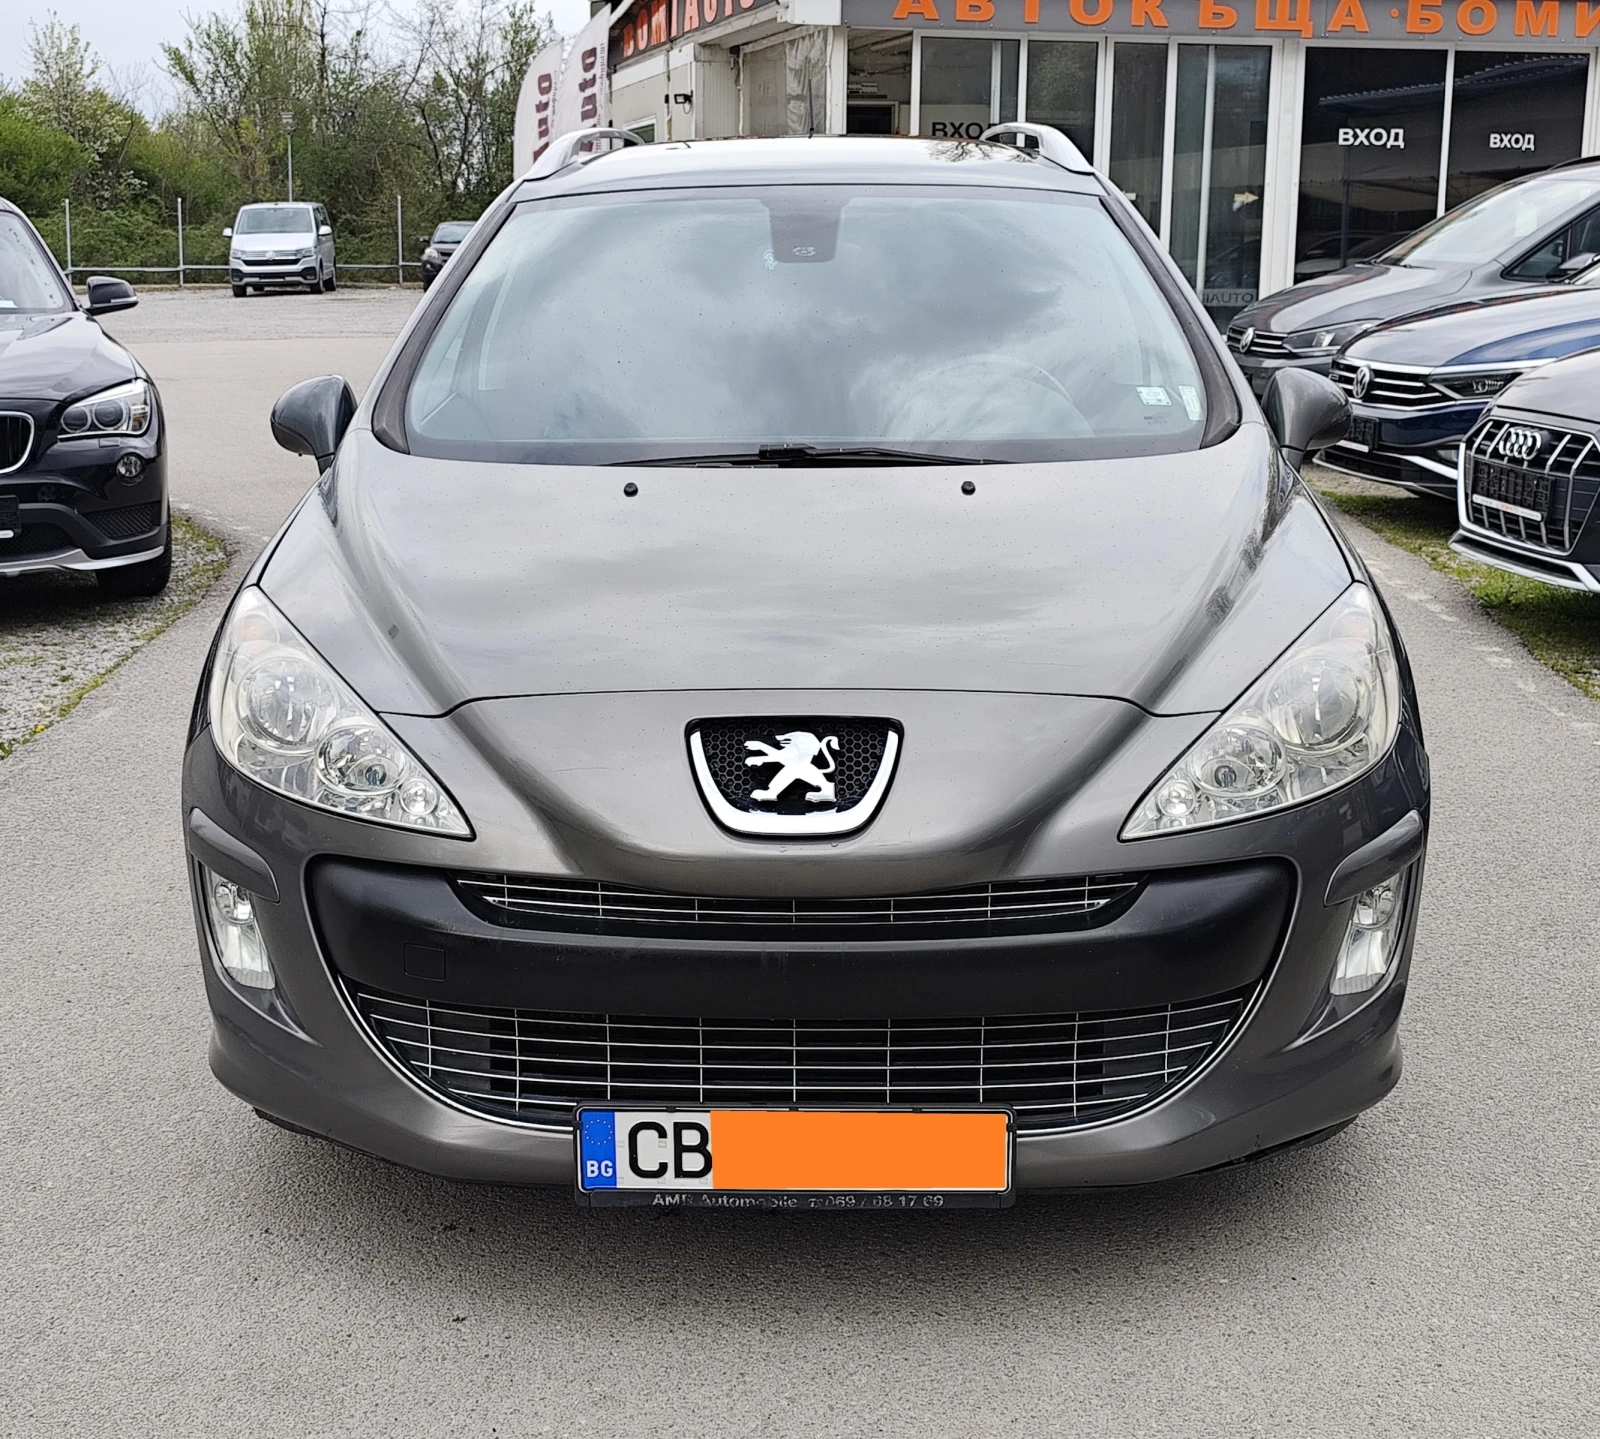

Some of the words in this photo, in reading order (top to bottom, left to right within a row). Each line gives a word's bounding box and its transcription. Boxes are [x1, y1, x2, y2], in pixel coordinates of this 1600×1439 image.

[622, 0, 757, 58] BOMIA
[932, 122, 998, 140] ВХО
[1337, 128, 1405, 149] ВХОД
[1489, 133, 1535, 151] ВХОД
[586, 1160, 613, 1178] BG
[899, 1195, 918, 1207] 17
